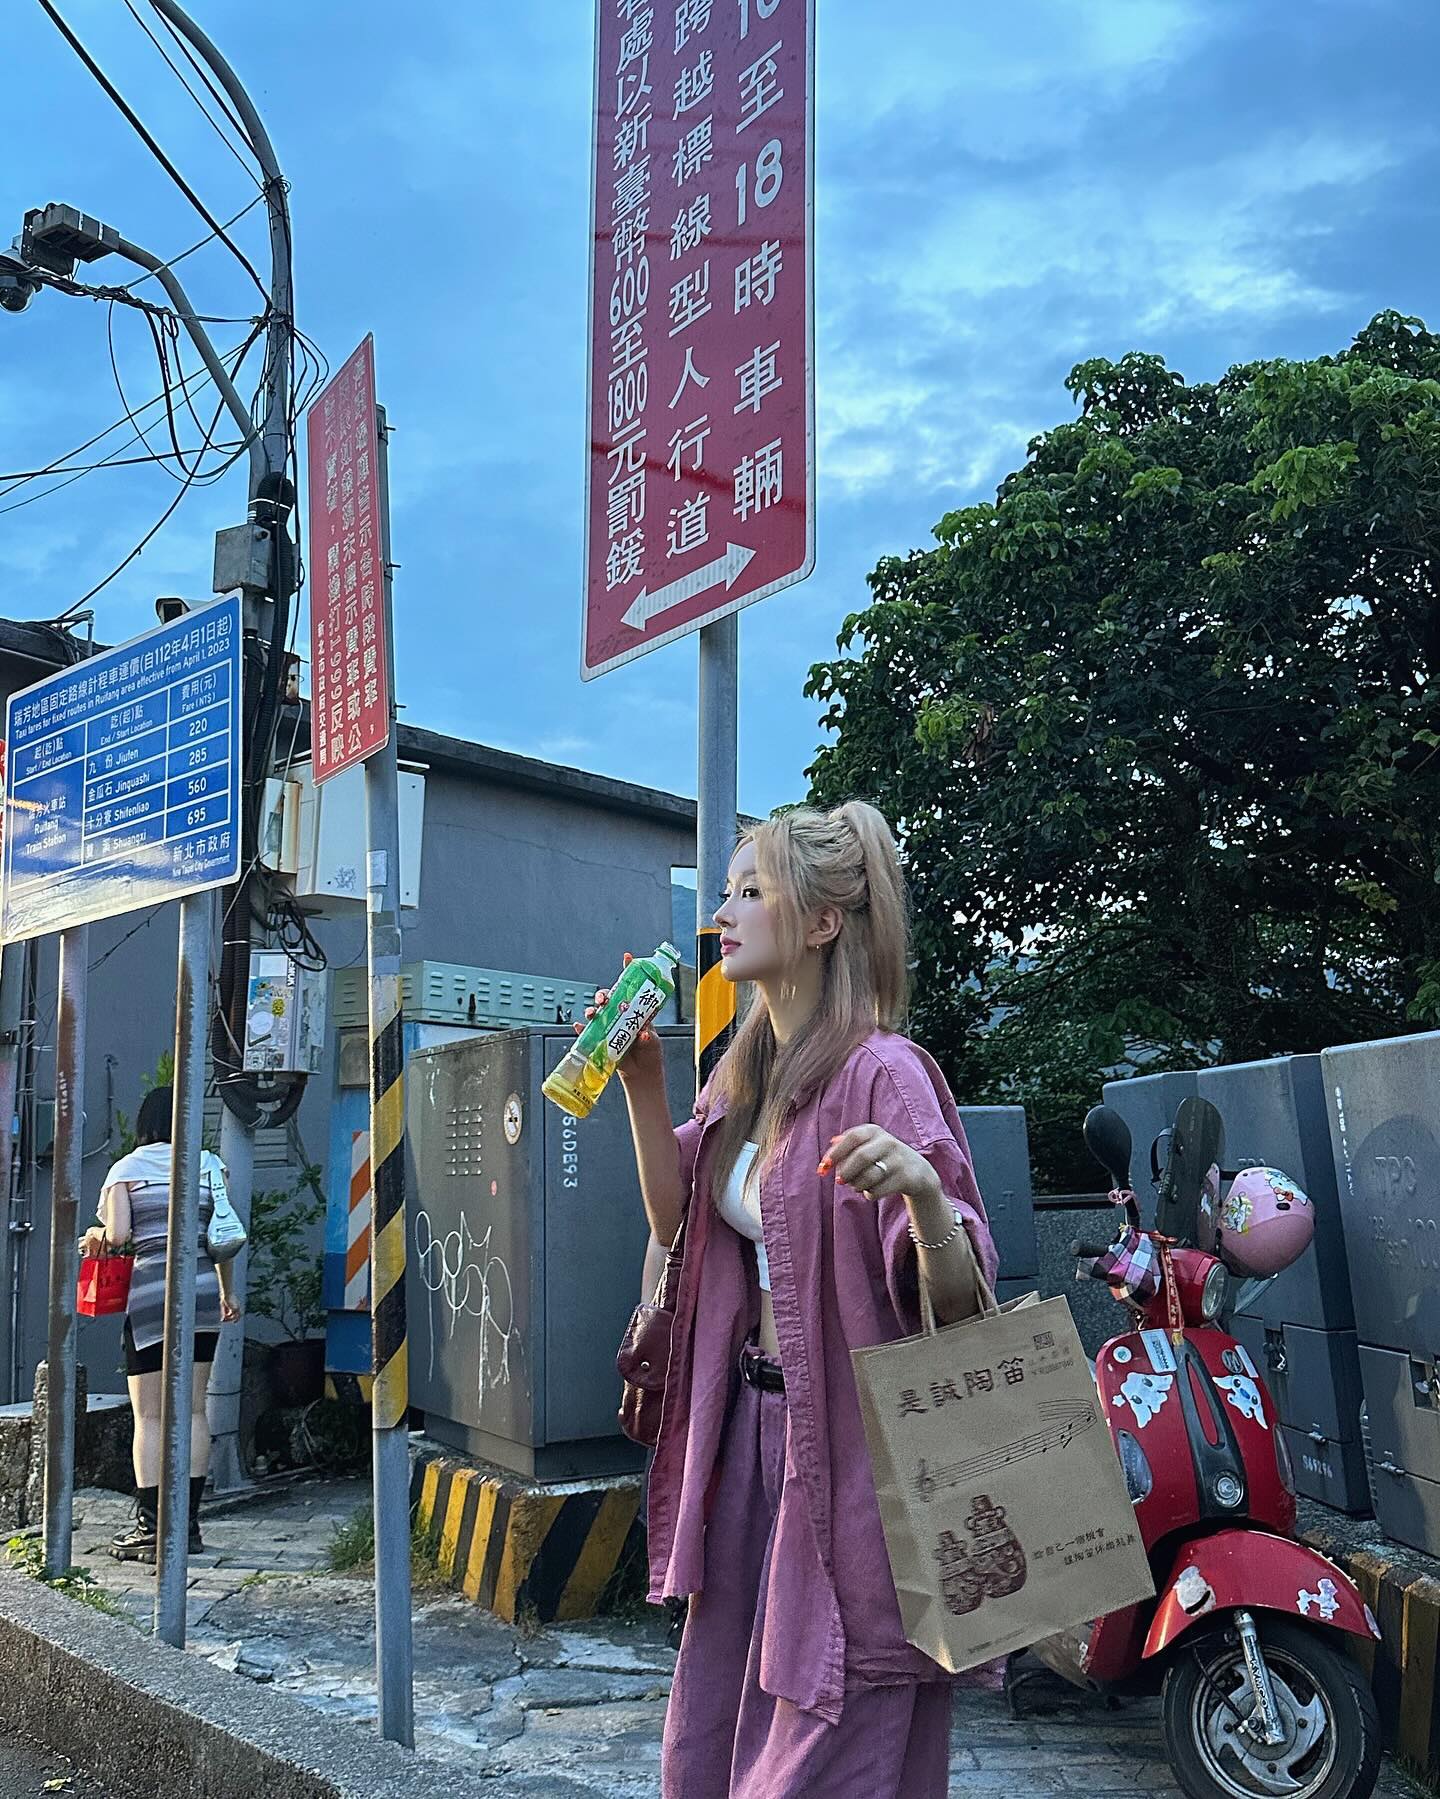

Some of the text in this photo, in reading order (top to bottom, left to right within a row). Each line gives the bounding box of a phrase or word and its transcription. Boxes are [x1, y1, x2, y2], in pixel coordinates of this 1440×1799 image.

[733, 0, 784, 522] 1至18時車輛
[15, 726, 27, 740] Taxi
[27, 720, 41, 735] fares
[42, 715, 51, 729] for
[52, 709, 66, 725] fixed
[66, 700, 86, 718] routes
[87, 697, 94, 709] in
[95, 686, 119, 710] Ruifang
[120, 681, 136, 695] area
[136, 666, 164, 688] effective
[165, 658, 182, 676] from
[182, 651, 200, 671] April
[207, 637, 230, 657] 2023
[181, 672, 216, 701] 費用(元)
[181, 700, 194, 714] Fare
[100, 734, 110, 746] End
[115, 726, 129, 740] Start
[130, 717, 153, 734] Location
[188, 717, 207, 737] 220
[25, 763, 37, 776] Start
[41, 758, 51, 769] End
[52, 749, 72, 765] Location
[115, 746, 138, 766] Jiufen
[188, 747, 207, 767] 285
[87, 770, 151, 803] 金瓜石 Jinguashi
[187, 777, 207, 796] 560
[113, 798, 150, 822] Shifenliao
[187, 807, 206, 826] 695
[42, 831, 66, 850] Station
[113, 829, 146, 853] Shuangxi
[172, 830, 231, 864] 新北市政府
[896, 1356, 1025, 1418] 是誠陶笛
